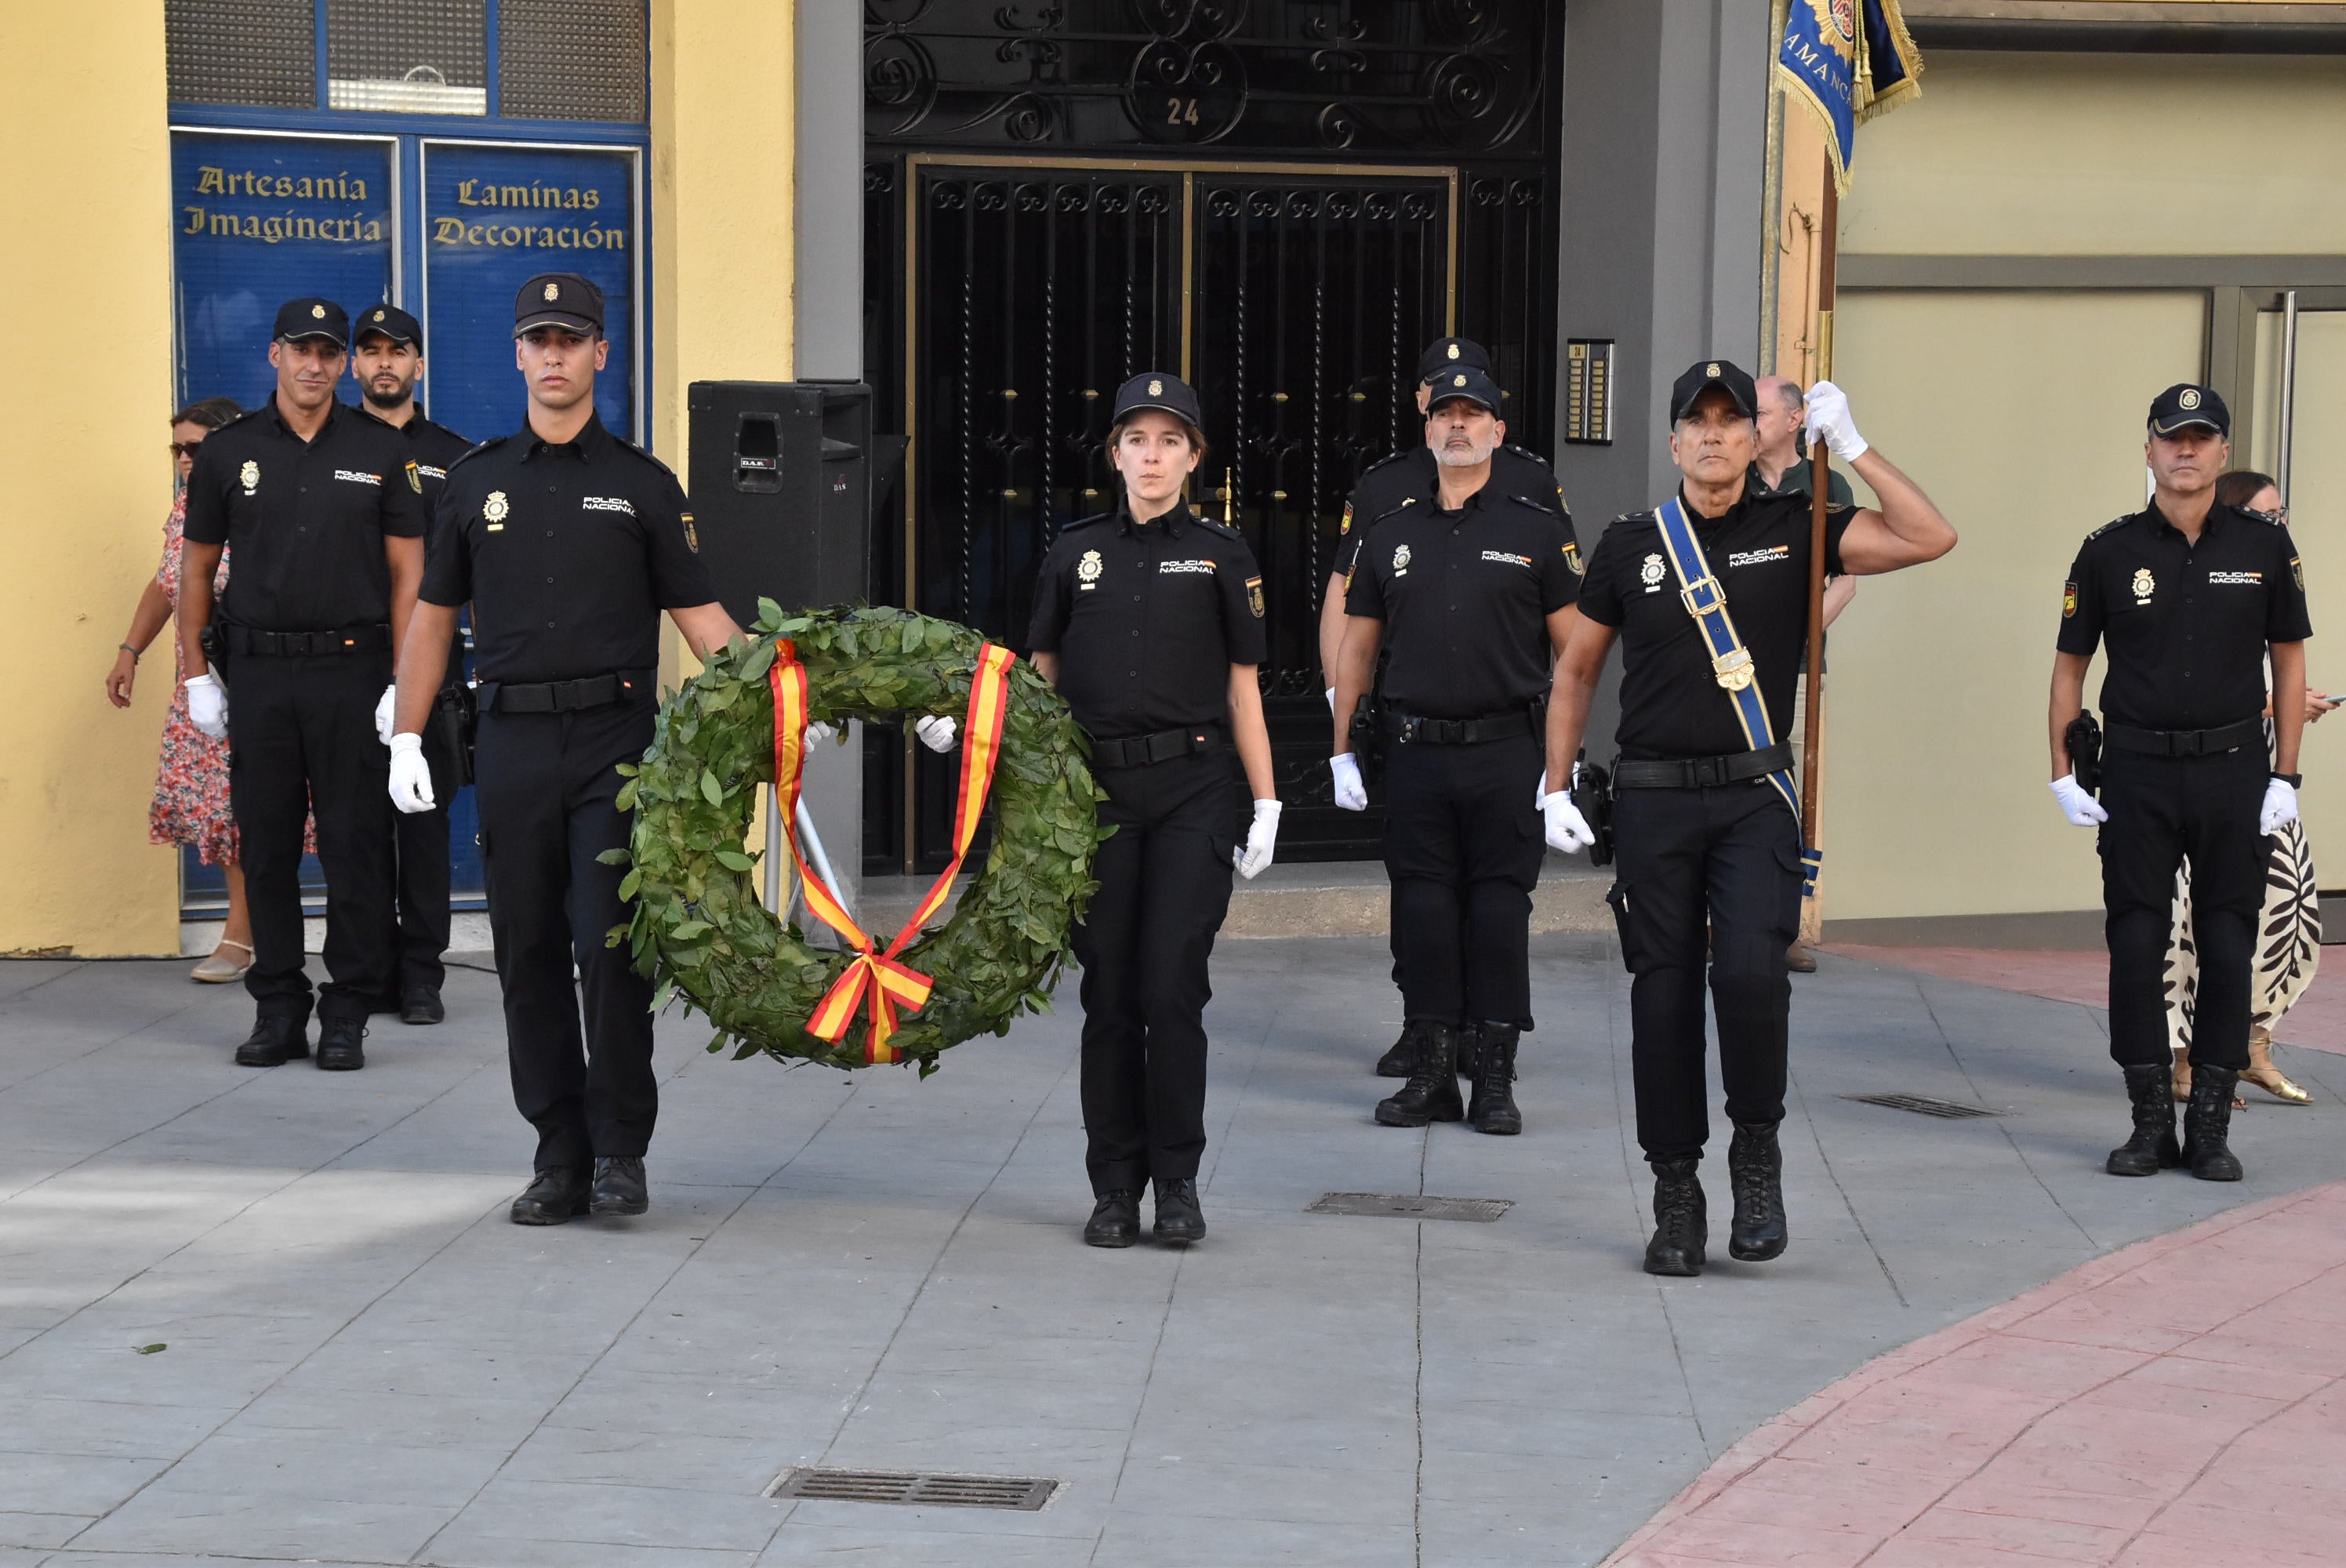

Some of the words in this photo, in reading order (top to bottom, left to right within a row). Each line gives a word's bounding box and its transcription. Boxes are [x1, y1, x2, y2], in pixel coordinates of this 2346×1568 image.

[1168, 98, 1198, 125] 24
[196, 165, 367, 200] Artesanía
[183, 206, 381, 243] Imaginería
[434, 216, 625, 249] Decoración
[1574, 347, 1581, 357] 24
[335, 470, 372, 479] POLICIA
[335, 475, 381, 485] NACIONAL
[583, 503, 637, 517] NACIONAL
[1482, 550, 1521, 559] POLICIA
[1729, 548, 1774, 561] POLICIA
[1730, 553, 1789, 567] NACIONAL
[1482, 555, 1531, 568] NACIONAL
